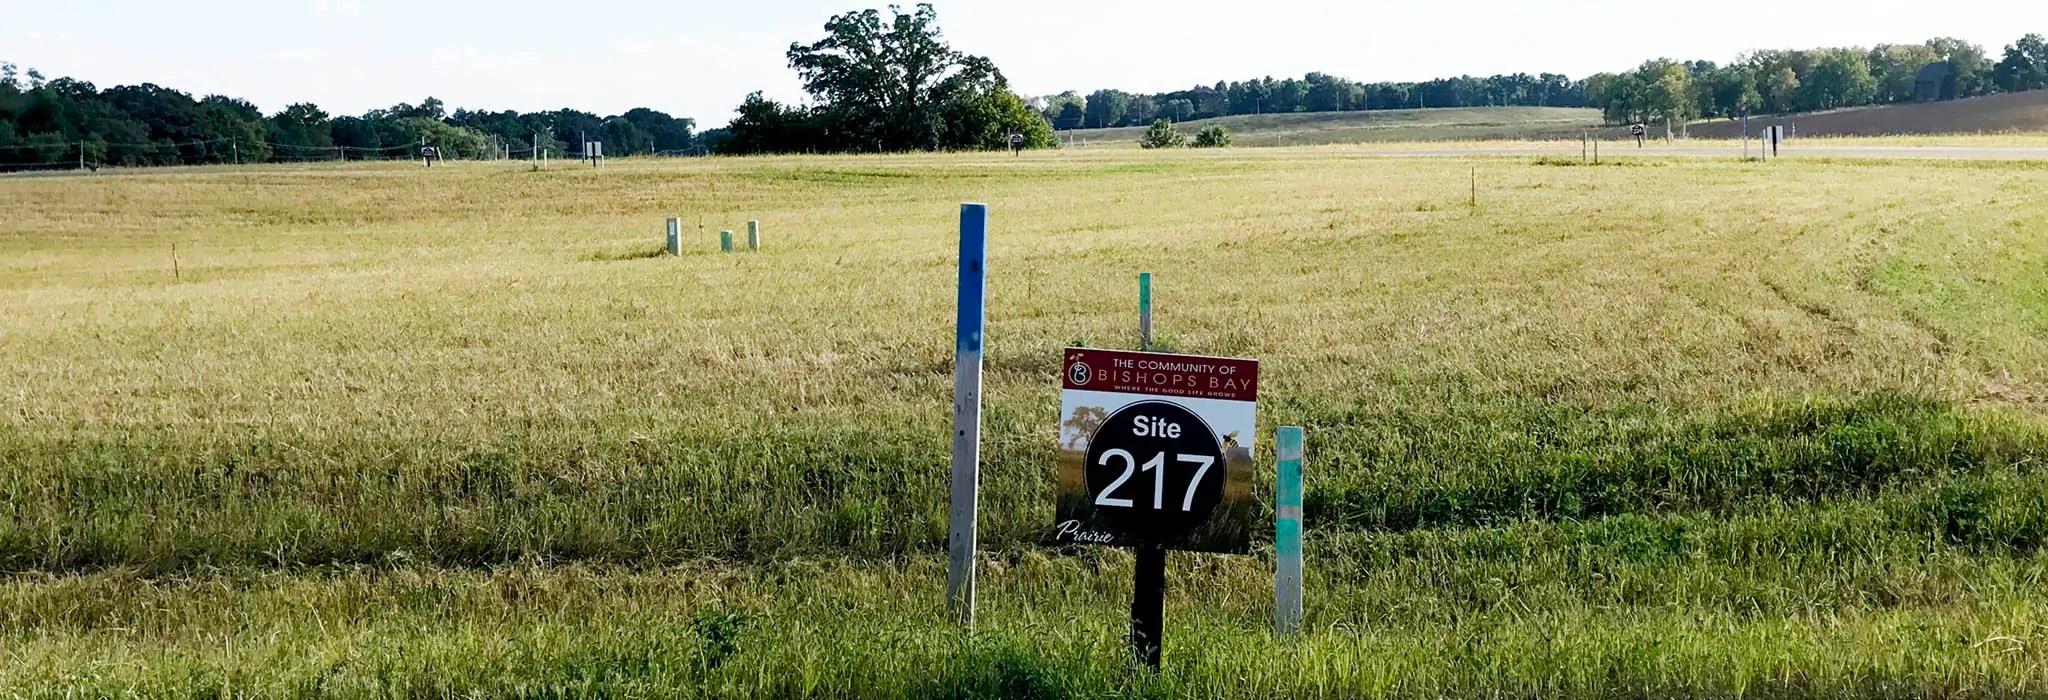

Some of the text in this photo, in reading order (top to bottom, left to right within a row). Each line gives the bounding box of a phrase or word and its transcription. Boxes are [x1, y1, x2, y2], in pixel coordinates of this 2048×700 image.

[1113, 358, 1237, 375] THE COMMUNITY OF
[1098, 369, 1251, 391] BISHOPS BAY
[1114, 384, 1141, 392] WHERE
[1132, 415, 1182, 438] Site
[1094, 448, 1215, 512] 217
[1056, 519, 1115, 544] Prairie
